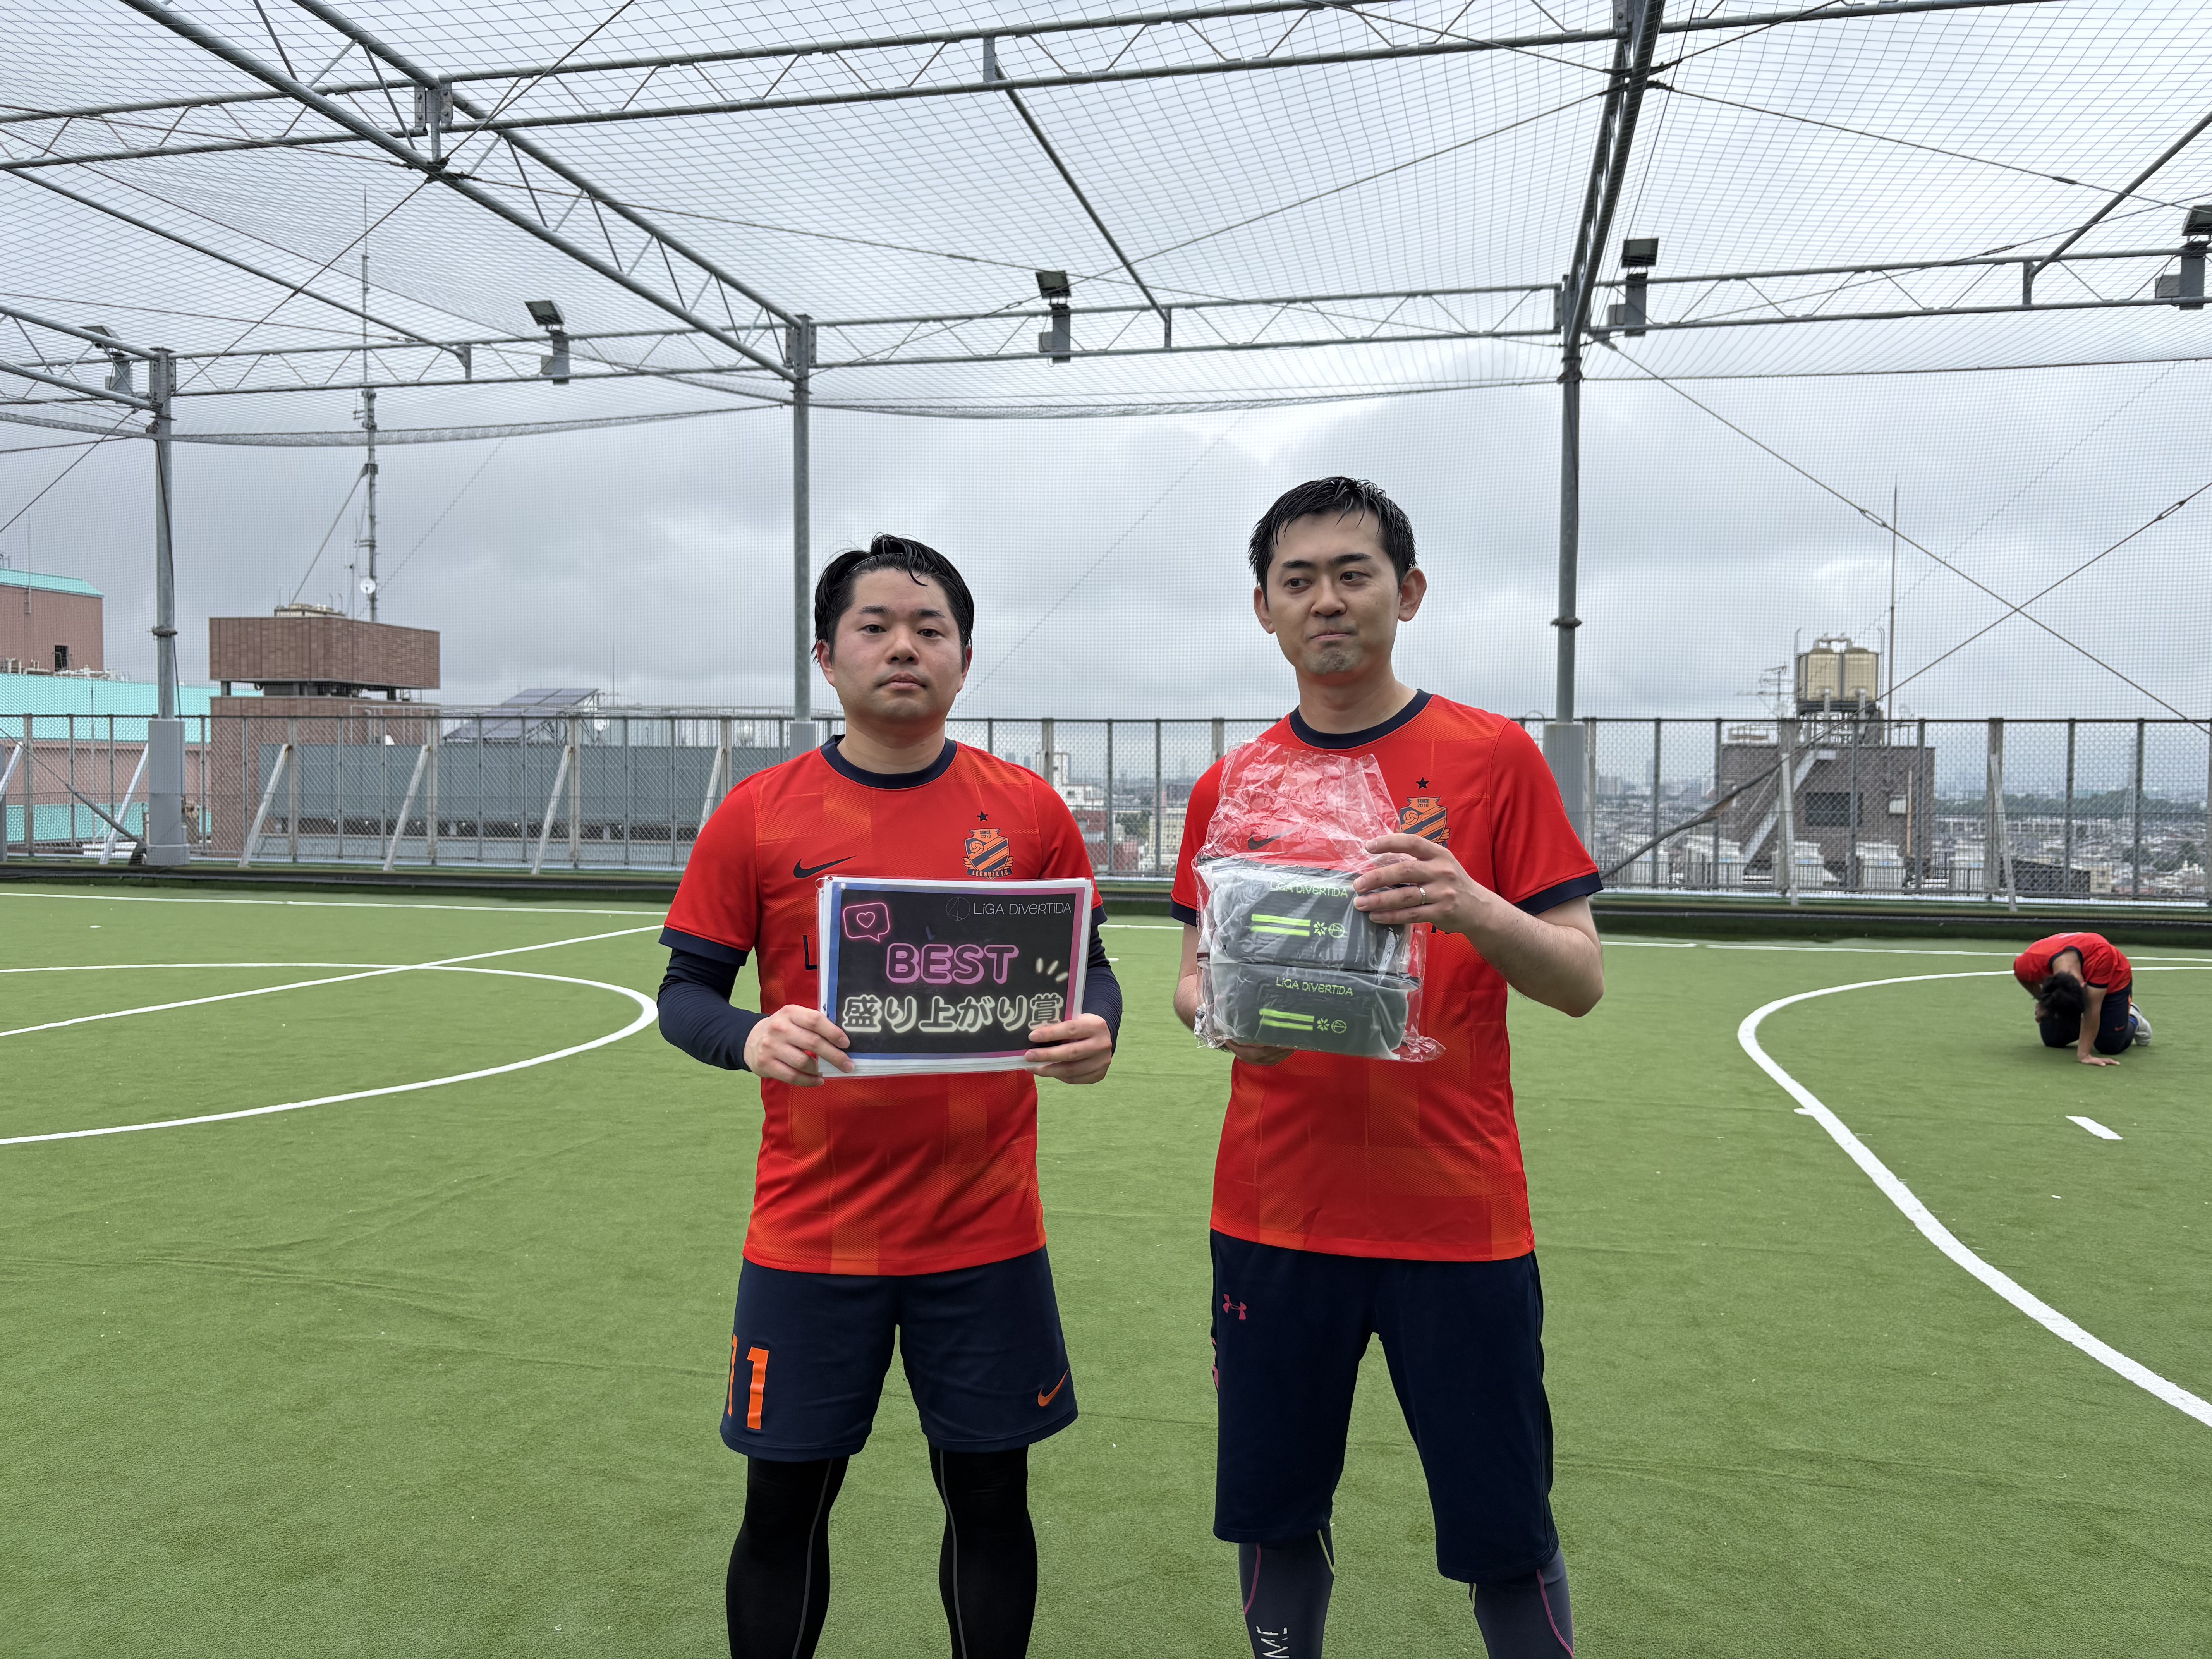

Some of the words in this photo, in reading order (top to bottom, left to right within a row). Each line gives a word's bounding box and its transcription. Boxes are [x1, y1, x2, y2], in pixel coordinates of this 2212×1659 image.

[886, 943, 1019, 984] BEST
[842, 992, 1064, 1033] 盛り上がり賞
